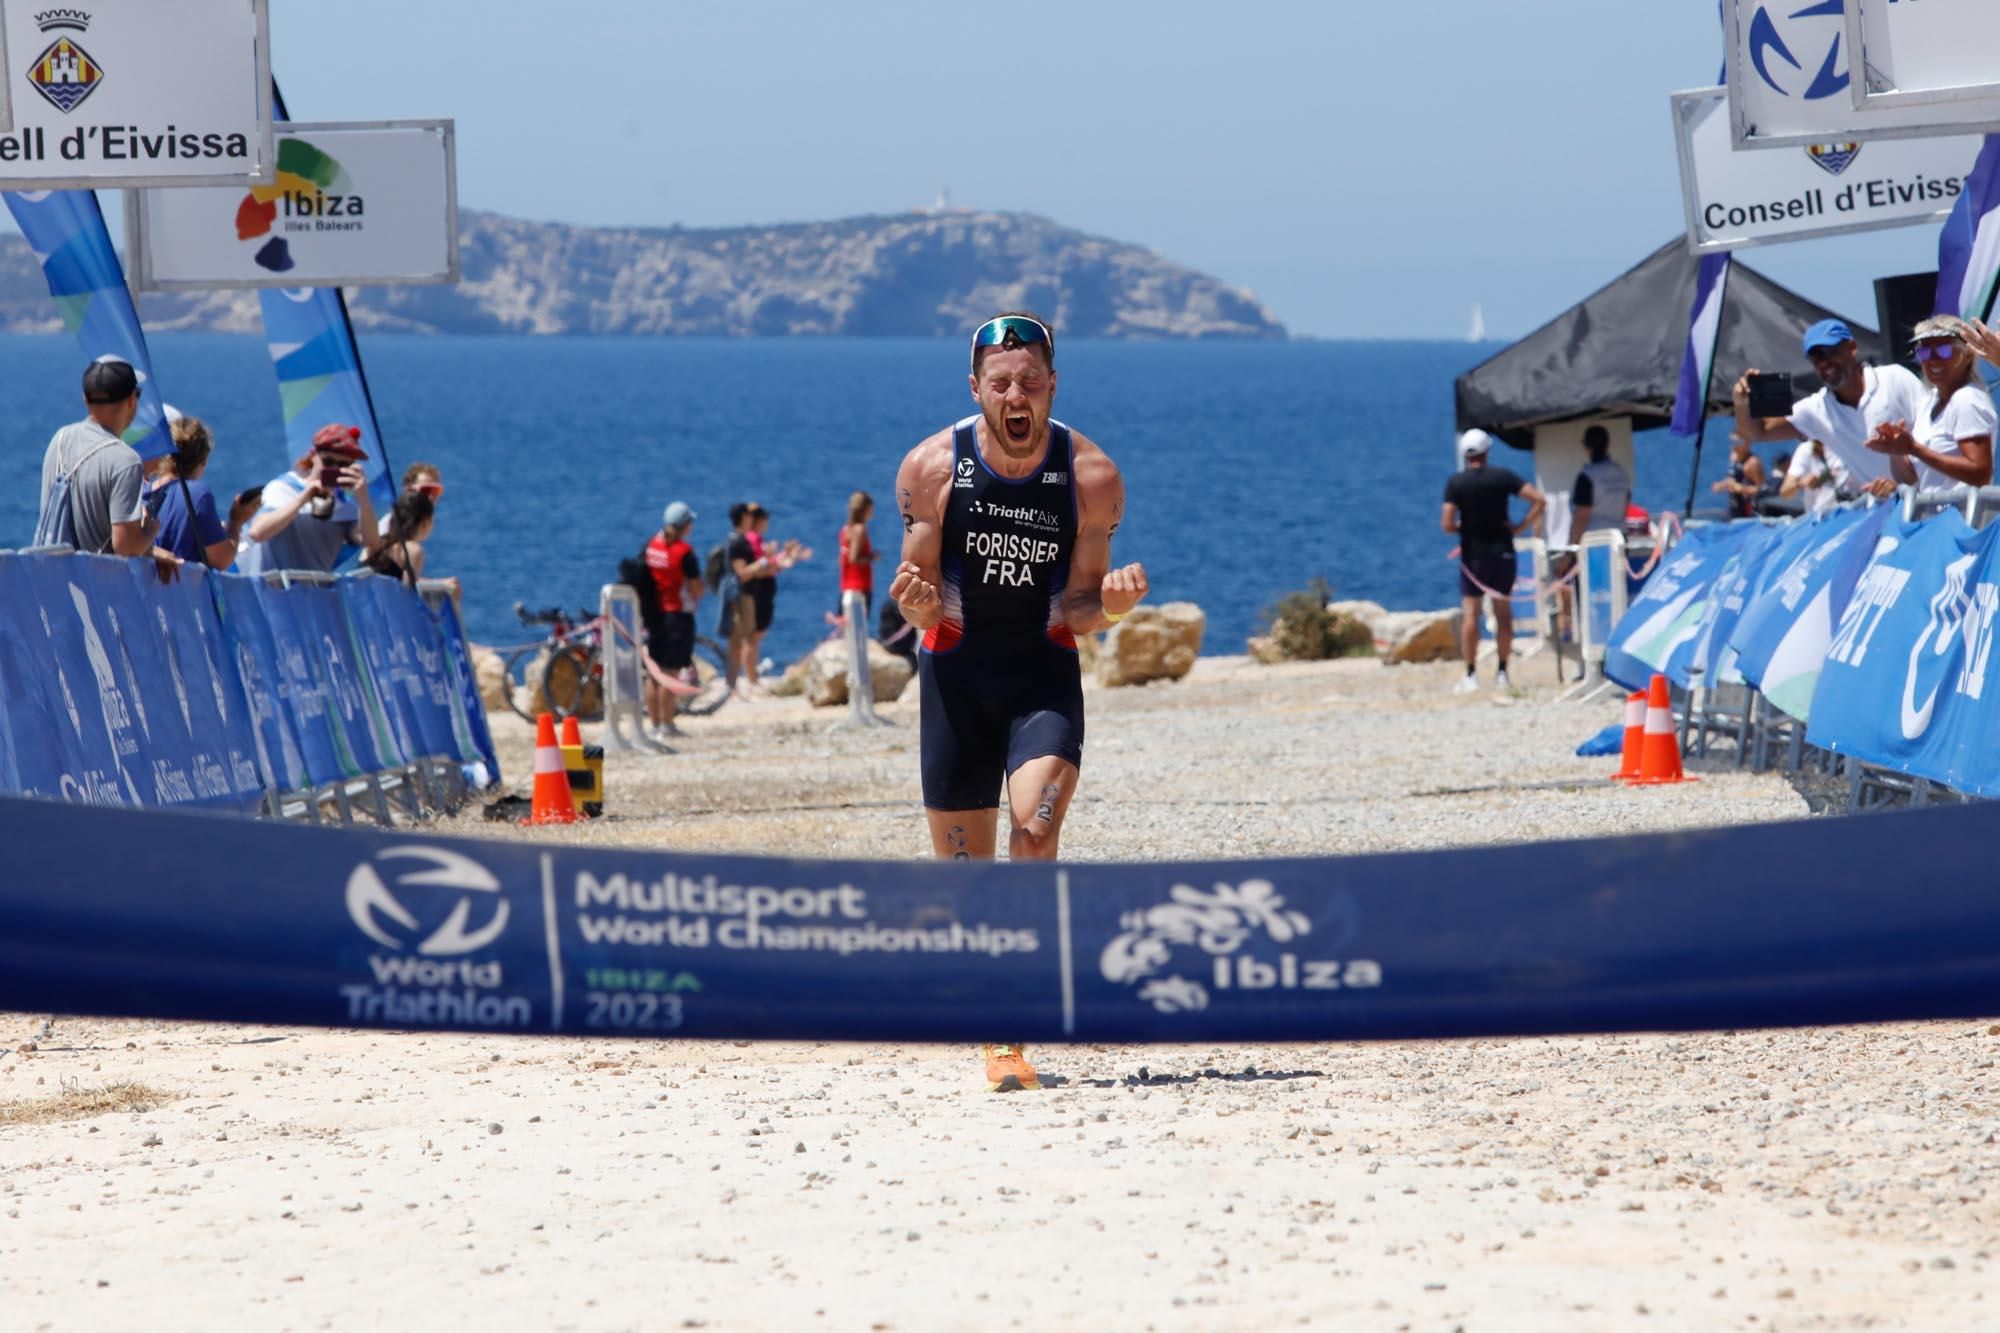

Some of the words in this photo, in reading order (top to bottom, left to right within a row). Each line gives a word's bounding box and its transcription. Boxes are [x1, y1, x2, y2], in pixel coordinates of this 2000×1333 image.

[60, 125, 248, 160] d'Eivissa
[283, 190, 364, 217] Ibiza
[1704, 189, 1823, 230] Consell
[1836, 174, 1970, 211] d'Eiviss
[285, 220, 312, 231] Illes
[315, 219, 363, 231] Balears
[966, 531, 1059, 564] FORISSIER
[983, 559, 1035, 586] FRA
[575, 870, 867, 926] Multisport
[578, 914, 709, 948] World
[716, 918, 1040, 957] Championships
[368, 955, 502, 988] World
[585, 967, 702, 991] IBIZA
[1213, 953, 1382, 989] Ibiza
[340, 984, 532, 1027] Triathlon
[585, 992, 684, 1030] 2023
